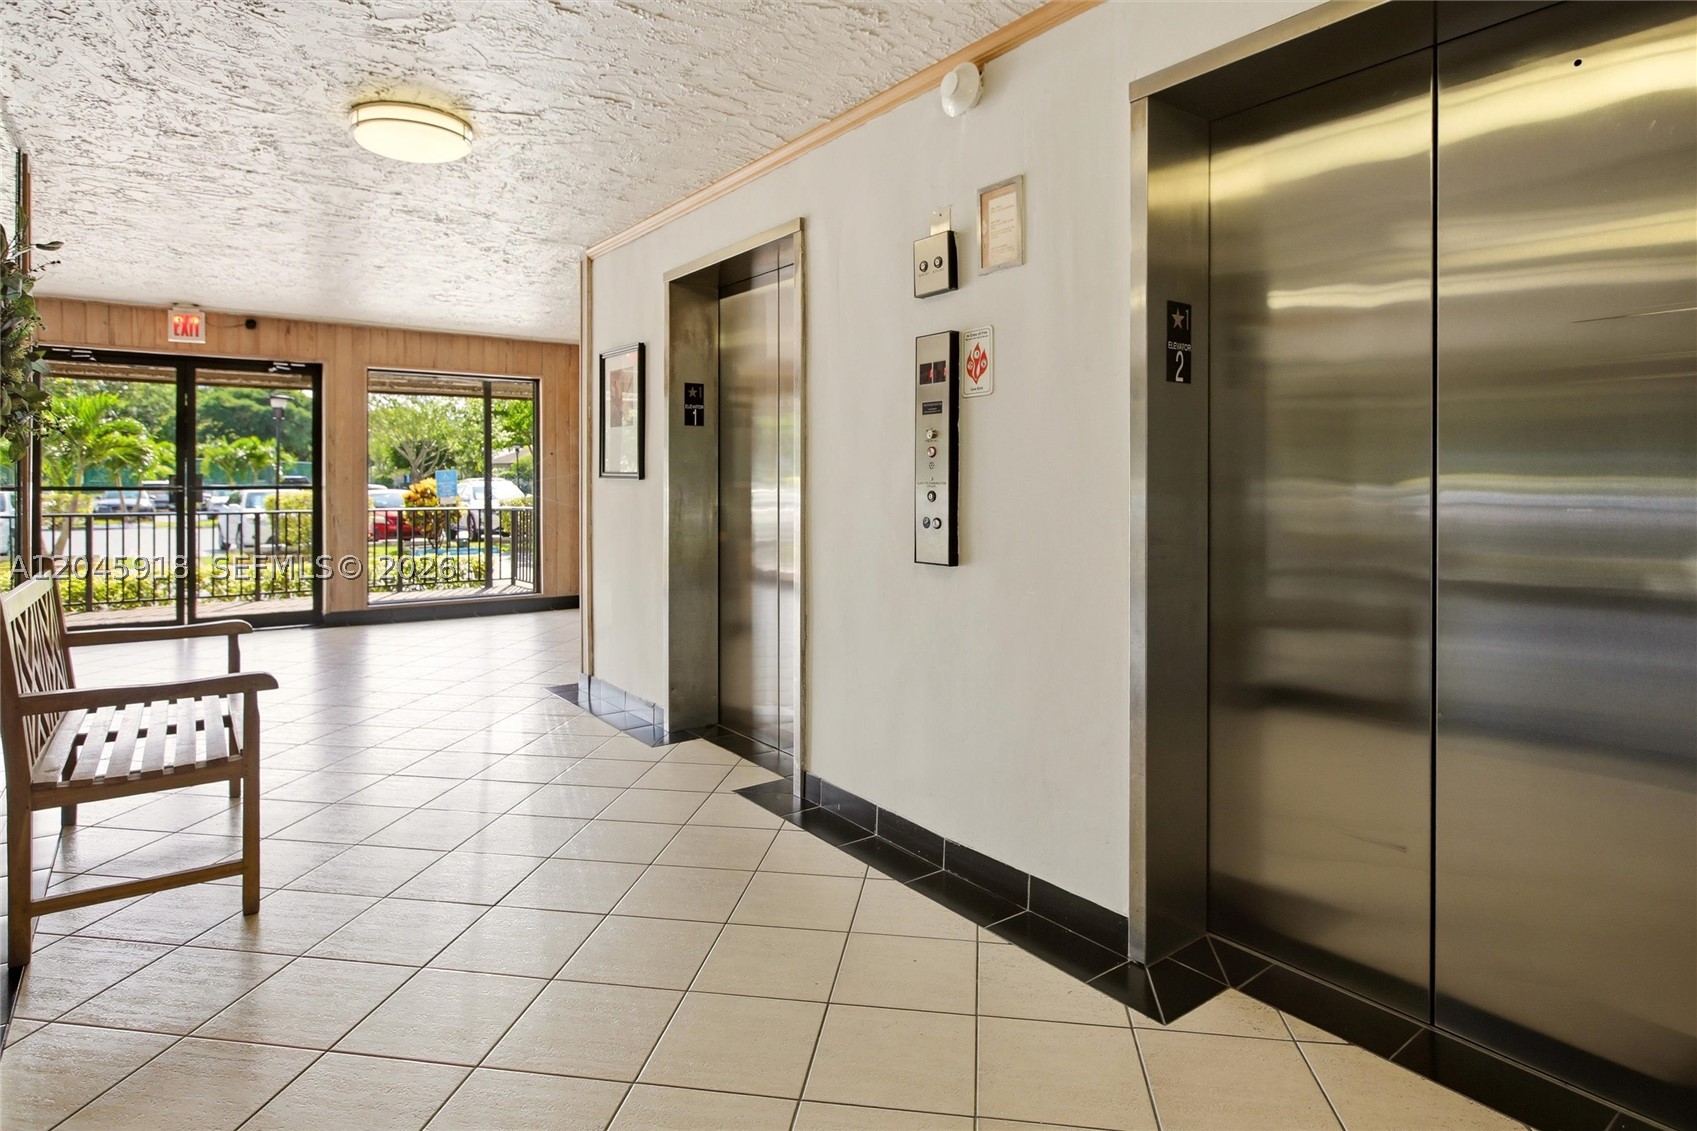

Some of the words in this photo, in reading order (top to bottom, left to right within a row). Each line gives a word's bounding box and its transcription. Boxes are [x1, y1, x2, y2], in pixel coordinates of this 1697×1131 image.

[1168, 341, 1191, 352] ELEVATOR
[1175, 350, 1184, 382] 2
[692, 409, 697, 426] 1
